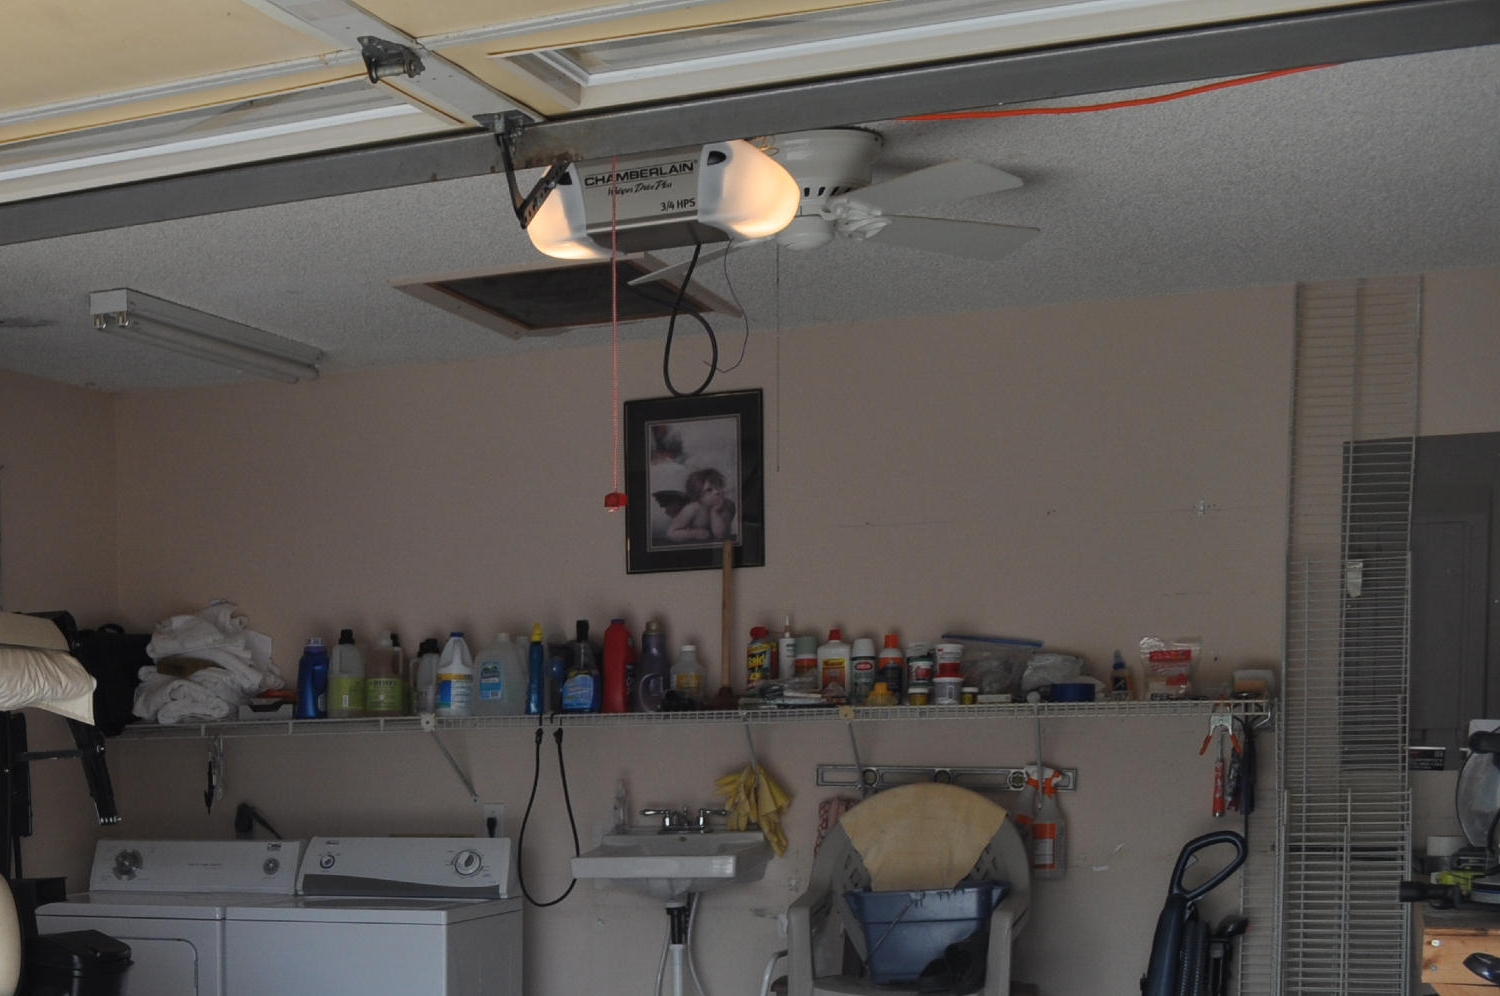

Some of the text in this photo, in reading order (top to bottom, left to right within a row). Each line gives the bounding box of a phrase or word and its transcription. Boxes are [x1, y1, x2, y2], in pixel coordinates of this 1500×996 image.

[584, 162, 695, 187] CHAMBERLAIN
[660, 197, 696, 212] 3/4 HPS
